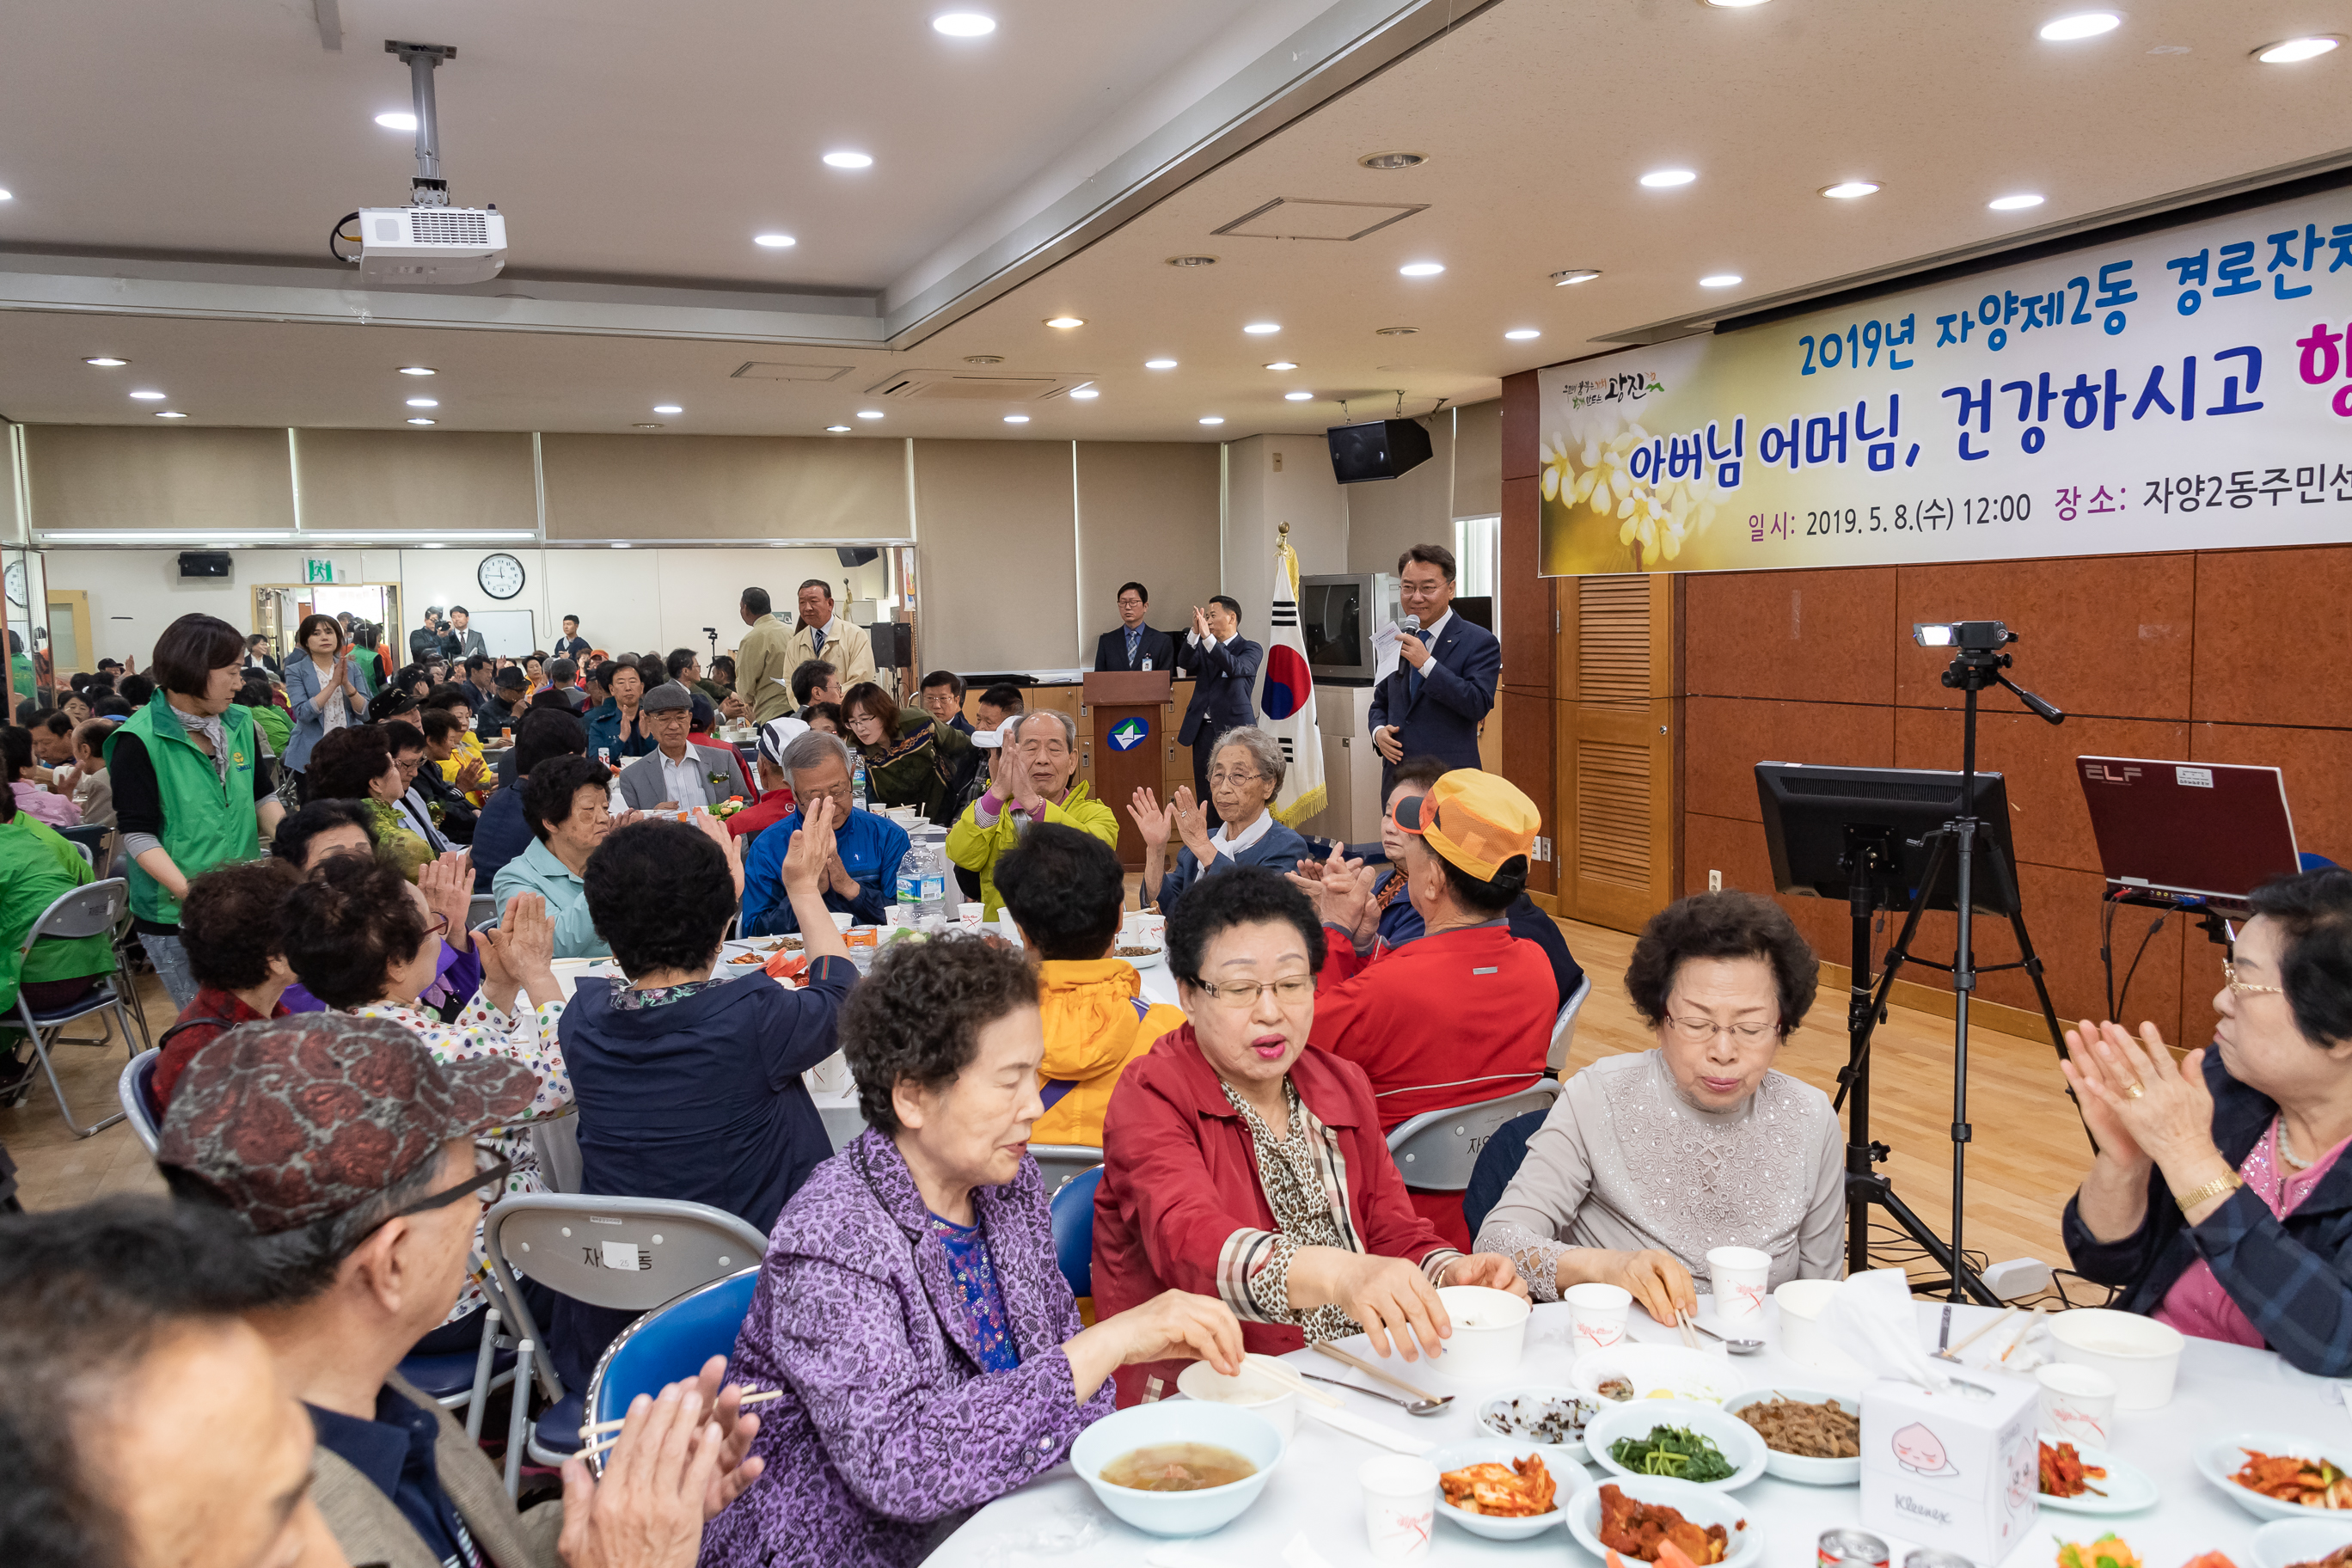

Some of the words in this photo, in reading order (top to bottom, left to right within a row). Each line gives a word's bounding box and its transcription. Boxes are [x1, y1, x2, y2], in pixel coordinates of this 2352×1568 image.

[1798, 313, 1915, 376] 2019년
[1936, 260, 2139, 352] 자양제2동
[1604, 372, 1647, 403] 광진
[1630, 418, 1743, 488] 아버님
[1760, 394, 1920, 472] 어머님,
[1941, 346, 2265, 462] 건강하시고
[1963, 493, 2031, 525] 12:00
[1467, 1135, 1491, 1154] 자
[619, 1259, 629, 1267] 25
[1895, 1493, 1952, 1524] Kleenex
